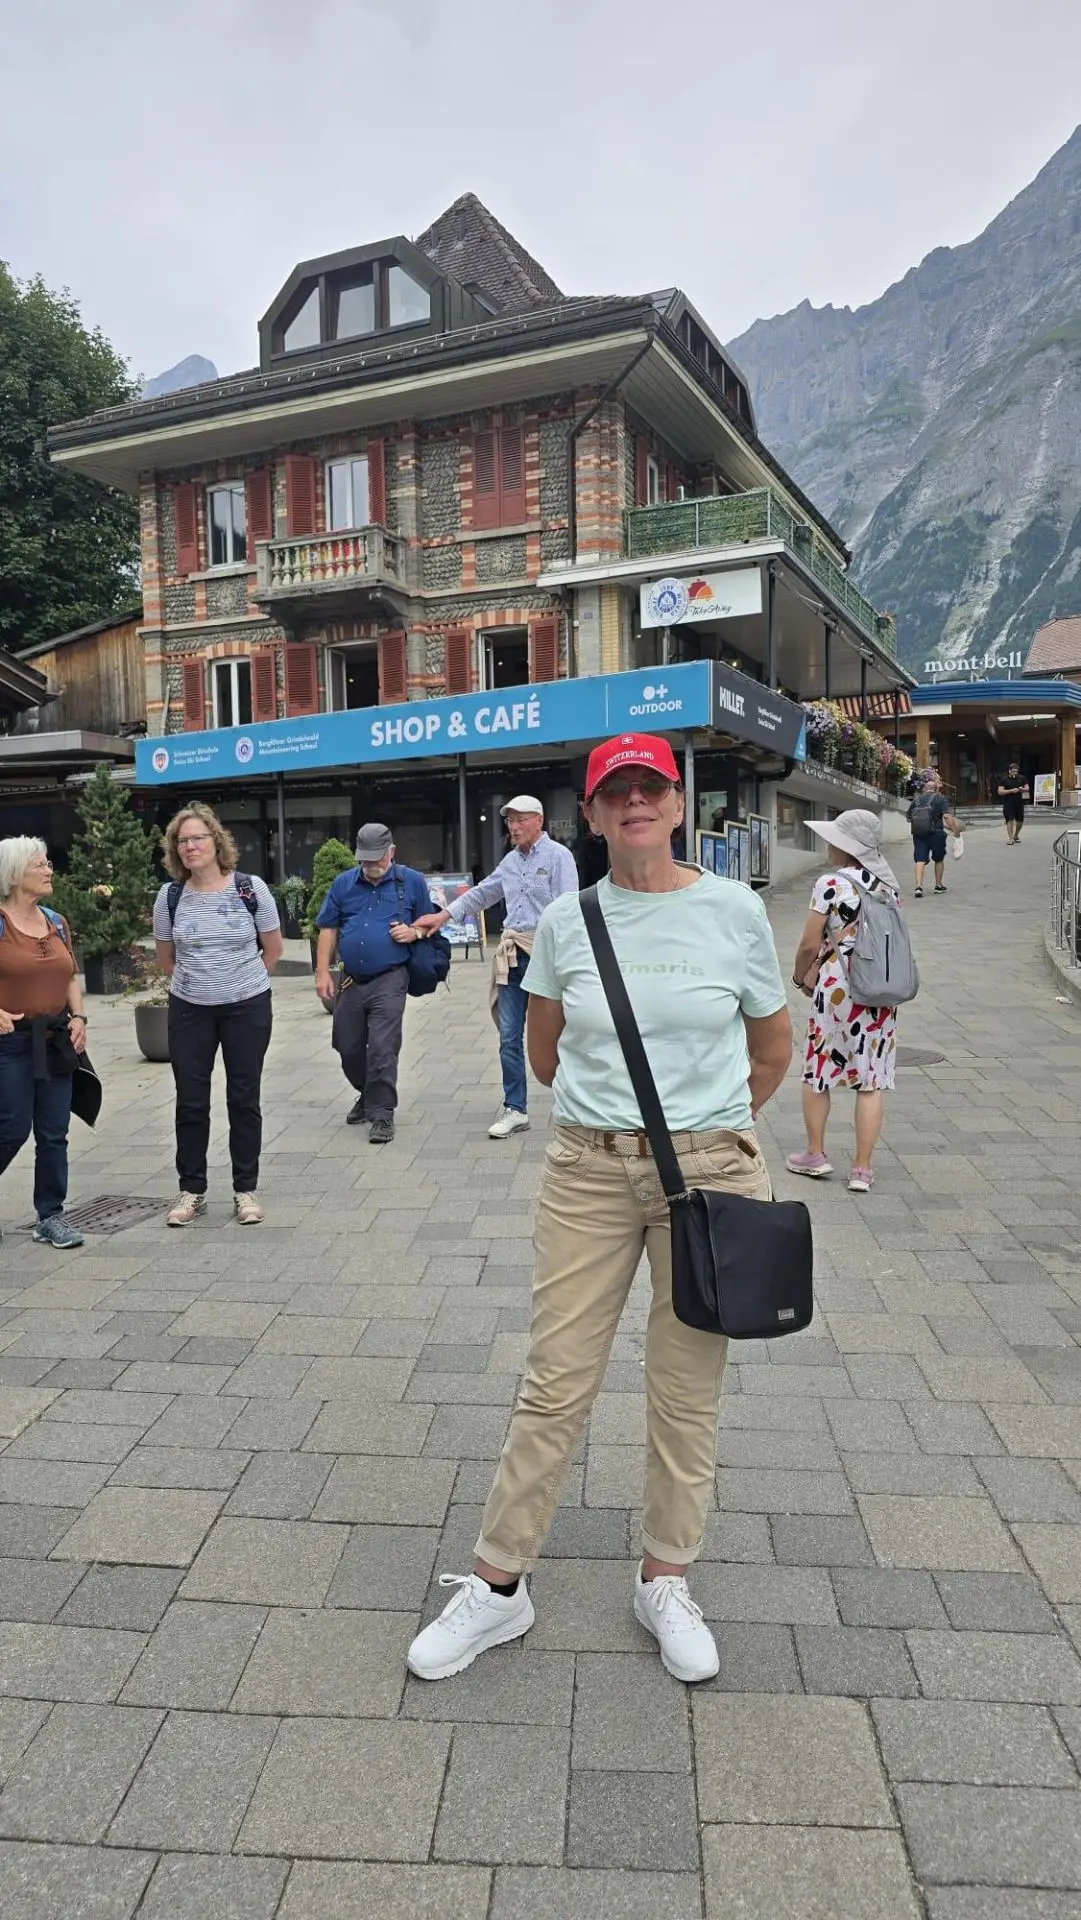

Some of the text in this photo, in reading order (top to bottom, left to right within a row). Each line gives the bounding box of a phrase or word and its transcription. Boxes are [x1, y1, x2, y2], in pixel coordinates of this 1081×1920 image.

[629, 700, 682, 716] OUTDOOR
[371, 693, 541, 747] SHOP & CAFÉ
[605, 750, 655, 769] SWITZERLAND
[620, 959, 705, 977] maris
